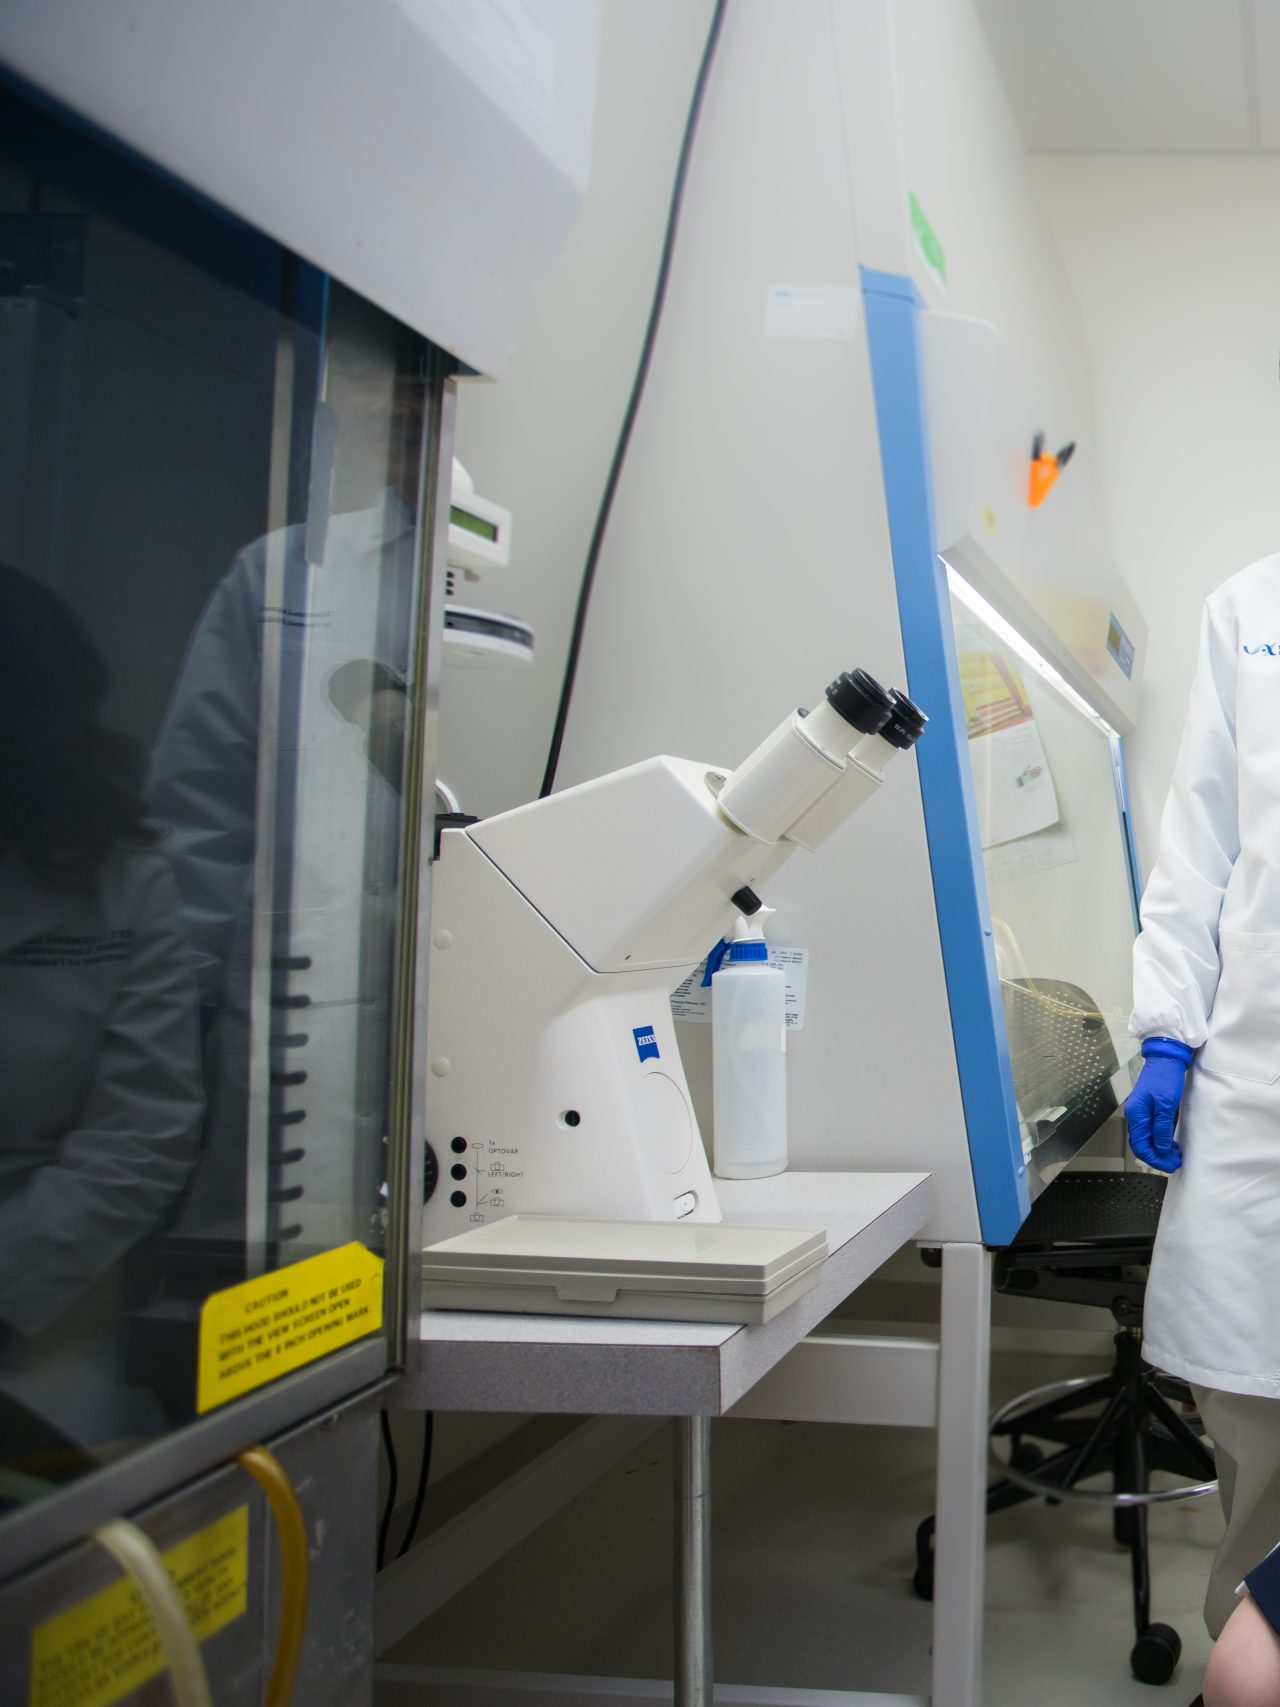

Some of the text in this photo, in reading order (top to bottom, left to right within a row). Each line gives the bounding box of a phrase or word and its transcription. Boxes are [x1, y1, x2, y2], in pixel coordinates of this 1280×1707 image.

[219, 1278, 362, 1345] THIS HOOD SHOULD NOT BE USED
[219, 1298, 350, 1362] WITH THE VIEW SCREEN OPEN
[244, 1288, 289, 1314] CAUTION
[218, 1359, 253, 1381] ABOVE
[255, 1350, 272, 1364] THE
[284, 1334, 307, 1350] INCH
[307, 1318, 344, 1341] OPENING
